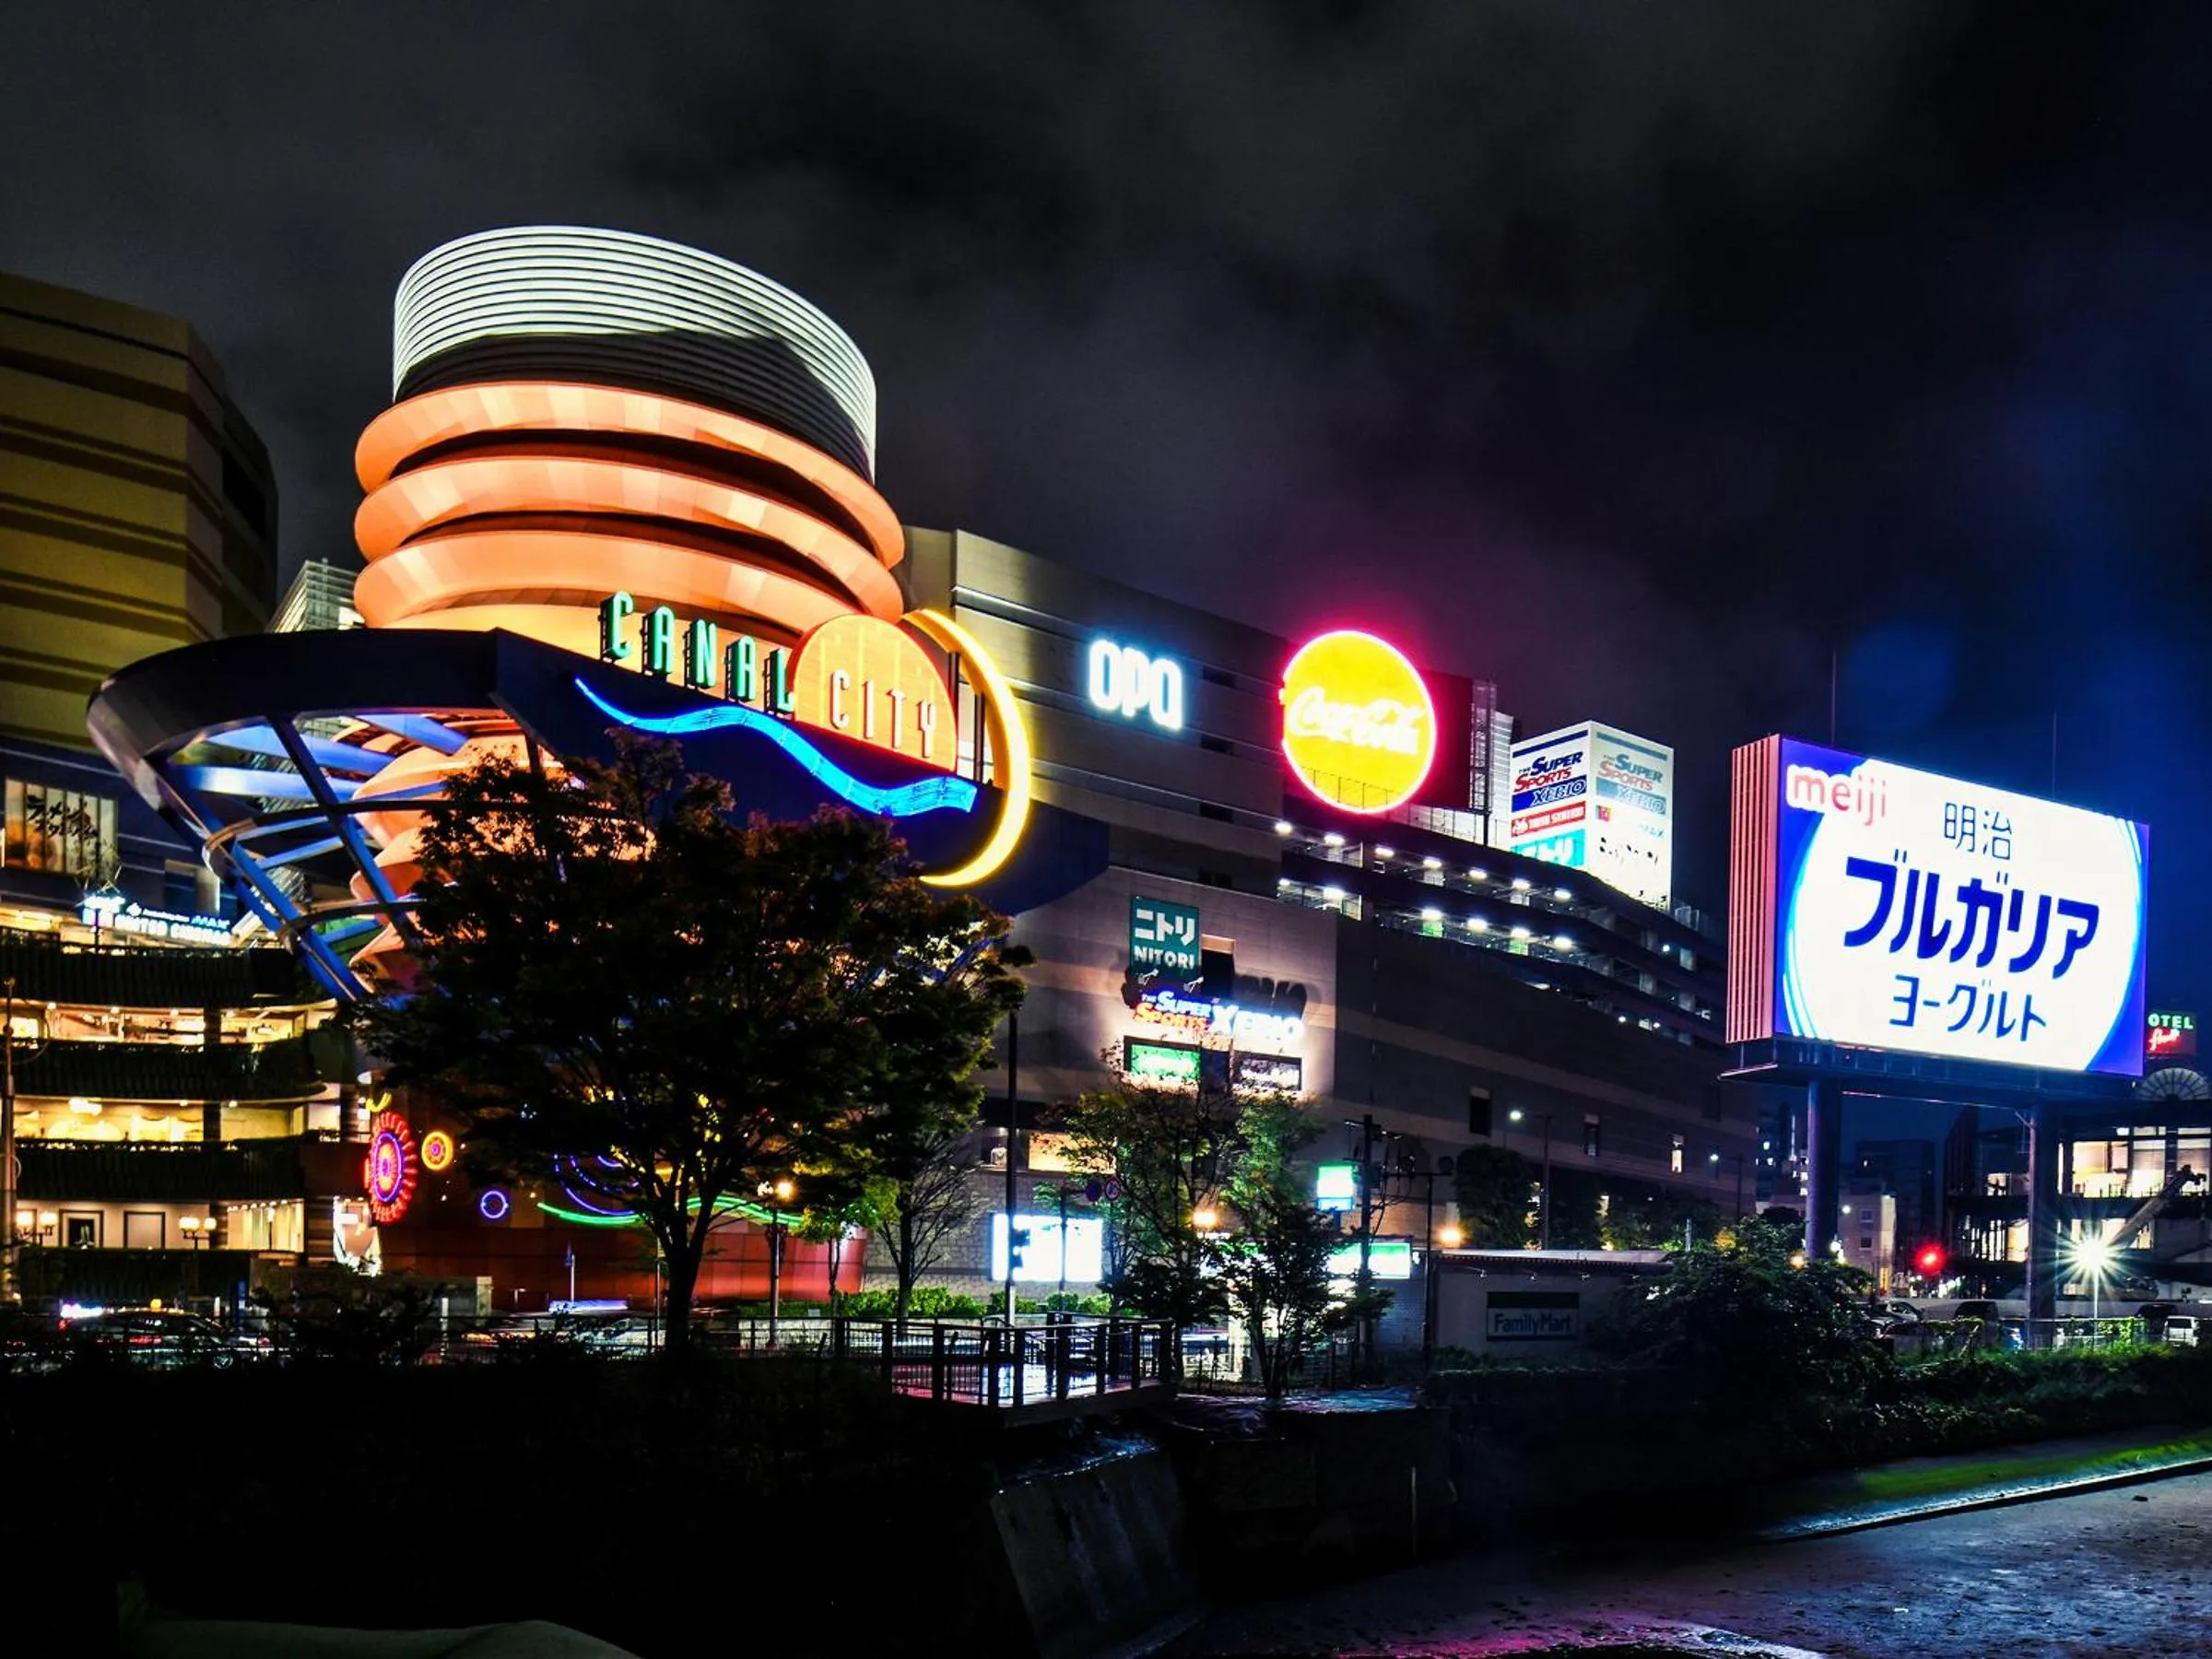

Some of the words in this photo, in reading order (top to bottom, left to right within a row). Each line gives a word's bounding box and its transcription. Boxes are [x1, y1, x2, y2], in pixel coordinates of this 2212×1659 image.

[601, 590, 794, 713] CANAL
[830, 669, 937, 759] CITY
[1530, 751, 1583, 776] SUPER
[1597, 760, 1653, 791] SPORTS
[1615, 753, 1664, 782] SUPER
[1513, 767, 1572, 793] SPORTS
[1793, 775, 1887, 826] meiji
[1944, 801, 2014, 861] 明治
[1135, 908, 1195, 946] ニトリ
[1843, 849, 2100, 980] ブルガリア
[1134, 945, 1195, 970] NITORI
[1156, 991, 1212, 1018] SUPER
[1889, 974, 2047, 1042] ヨーグルト
[2147, 1013, 2194, 1030] OTEL
[1494, 1312, 1572, 1335] FamilyMart
